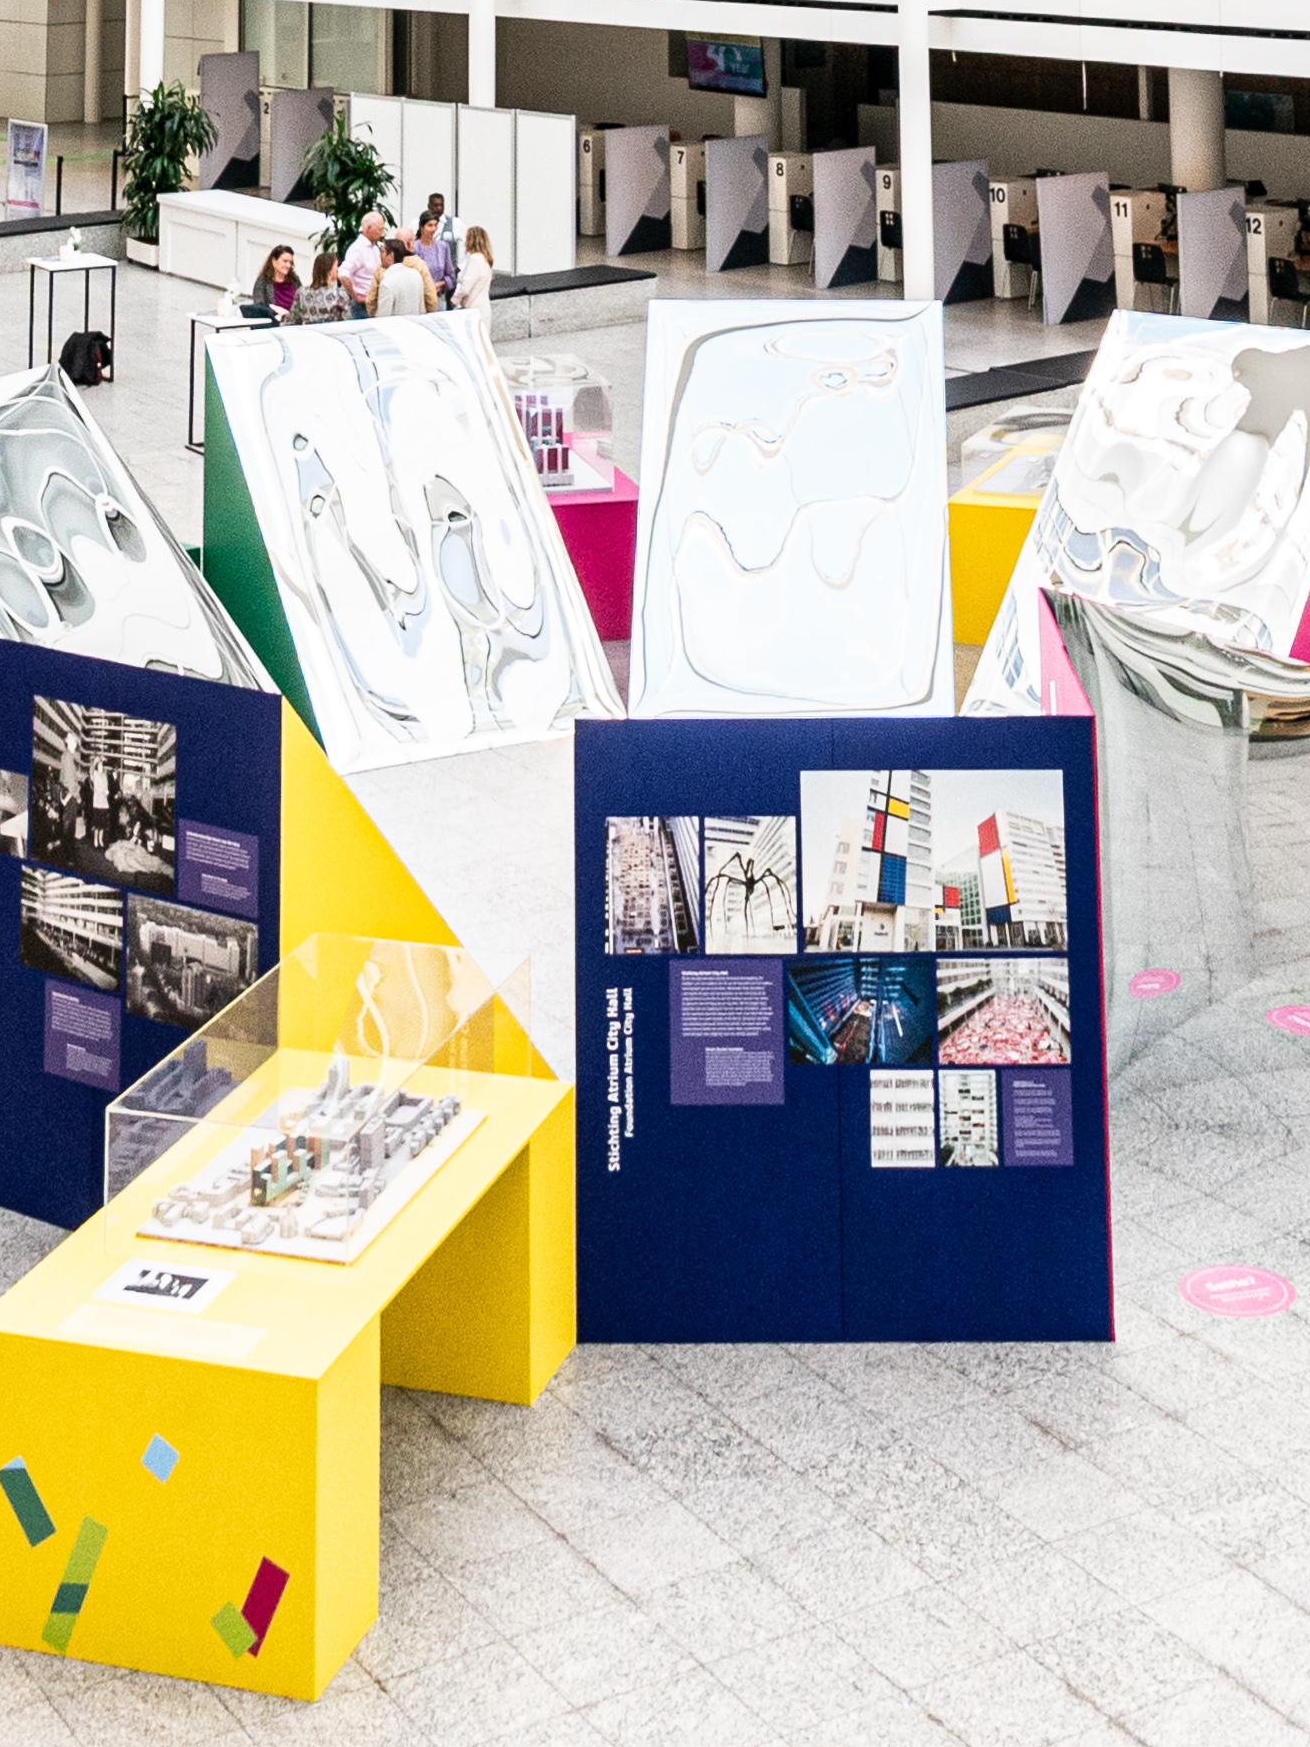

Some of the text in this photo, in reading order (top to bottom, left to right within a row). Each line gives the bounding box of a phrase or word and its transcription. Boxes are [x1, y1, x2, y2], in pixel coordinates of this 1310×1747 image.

[583, 139, 591, 154] 6
[677, 150, 685, 165] 7
[775, 161, 784, 177] 8
[882, 174, 891, 190] 9
[989, 187, 1006, 203] 10
[1114, 201, 1129, 218] 11
[1245, 217, 1262, 234] 12
[623, 987, 635, 1138] Foundation Atrium City Hall
[606, 987, 622, 1173] Stichting Atrium City Hall
